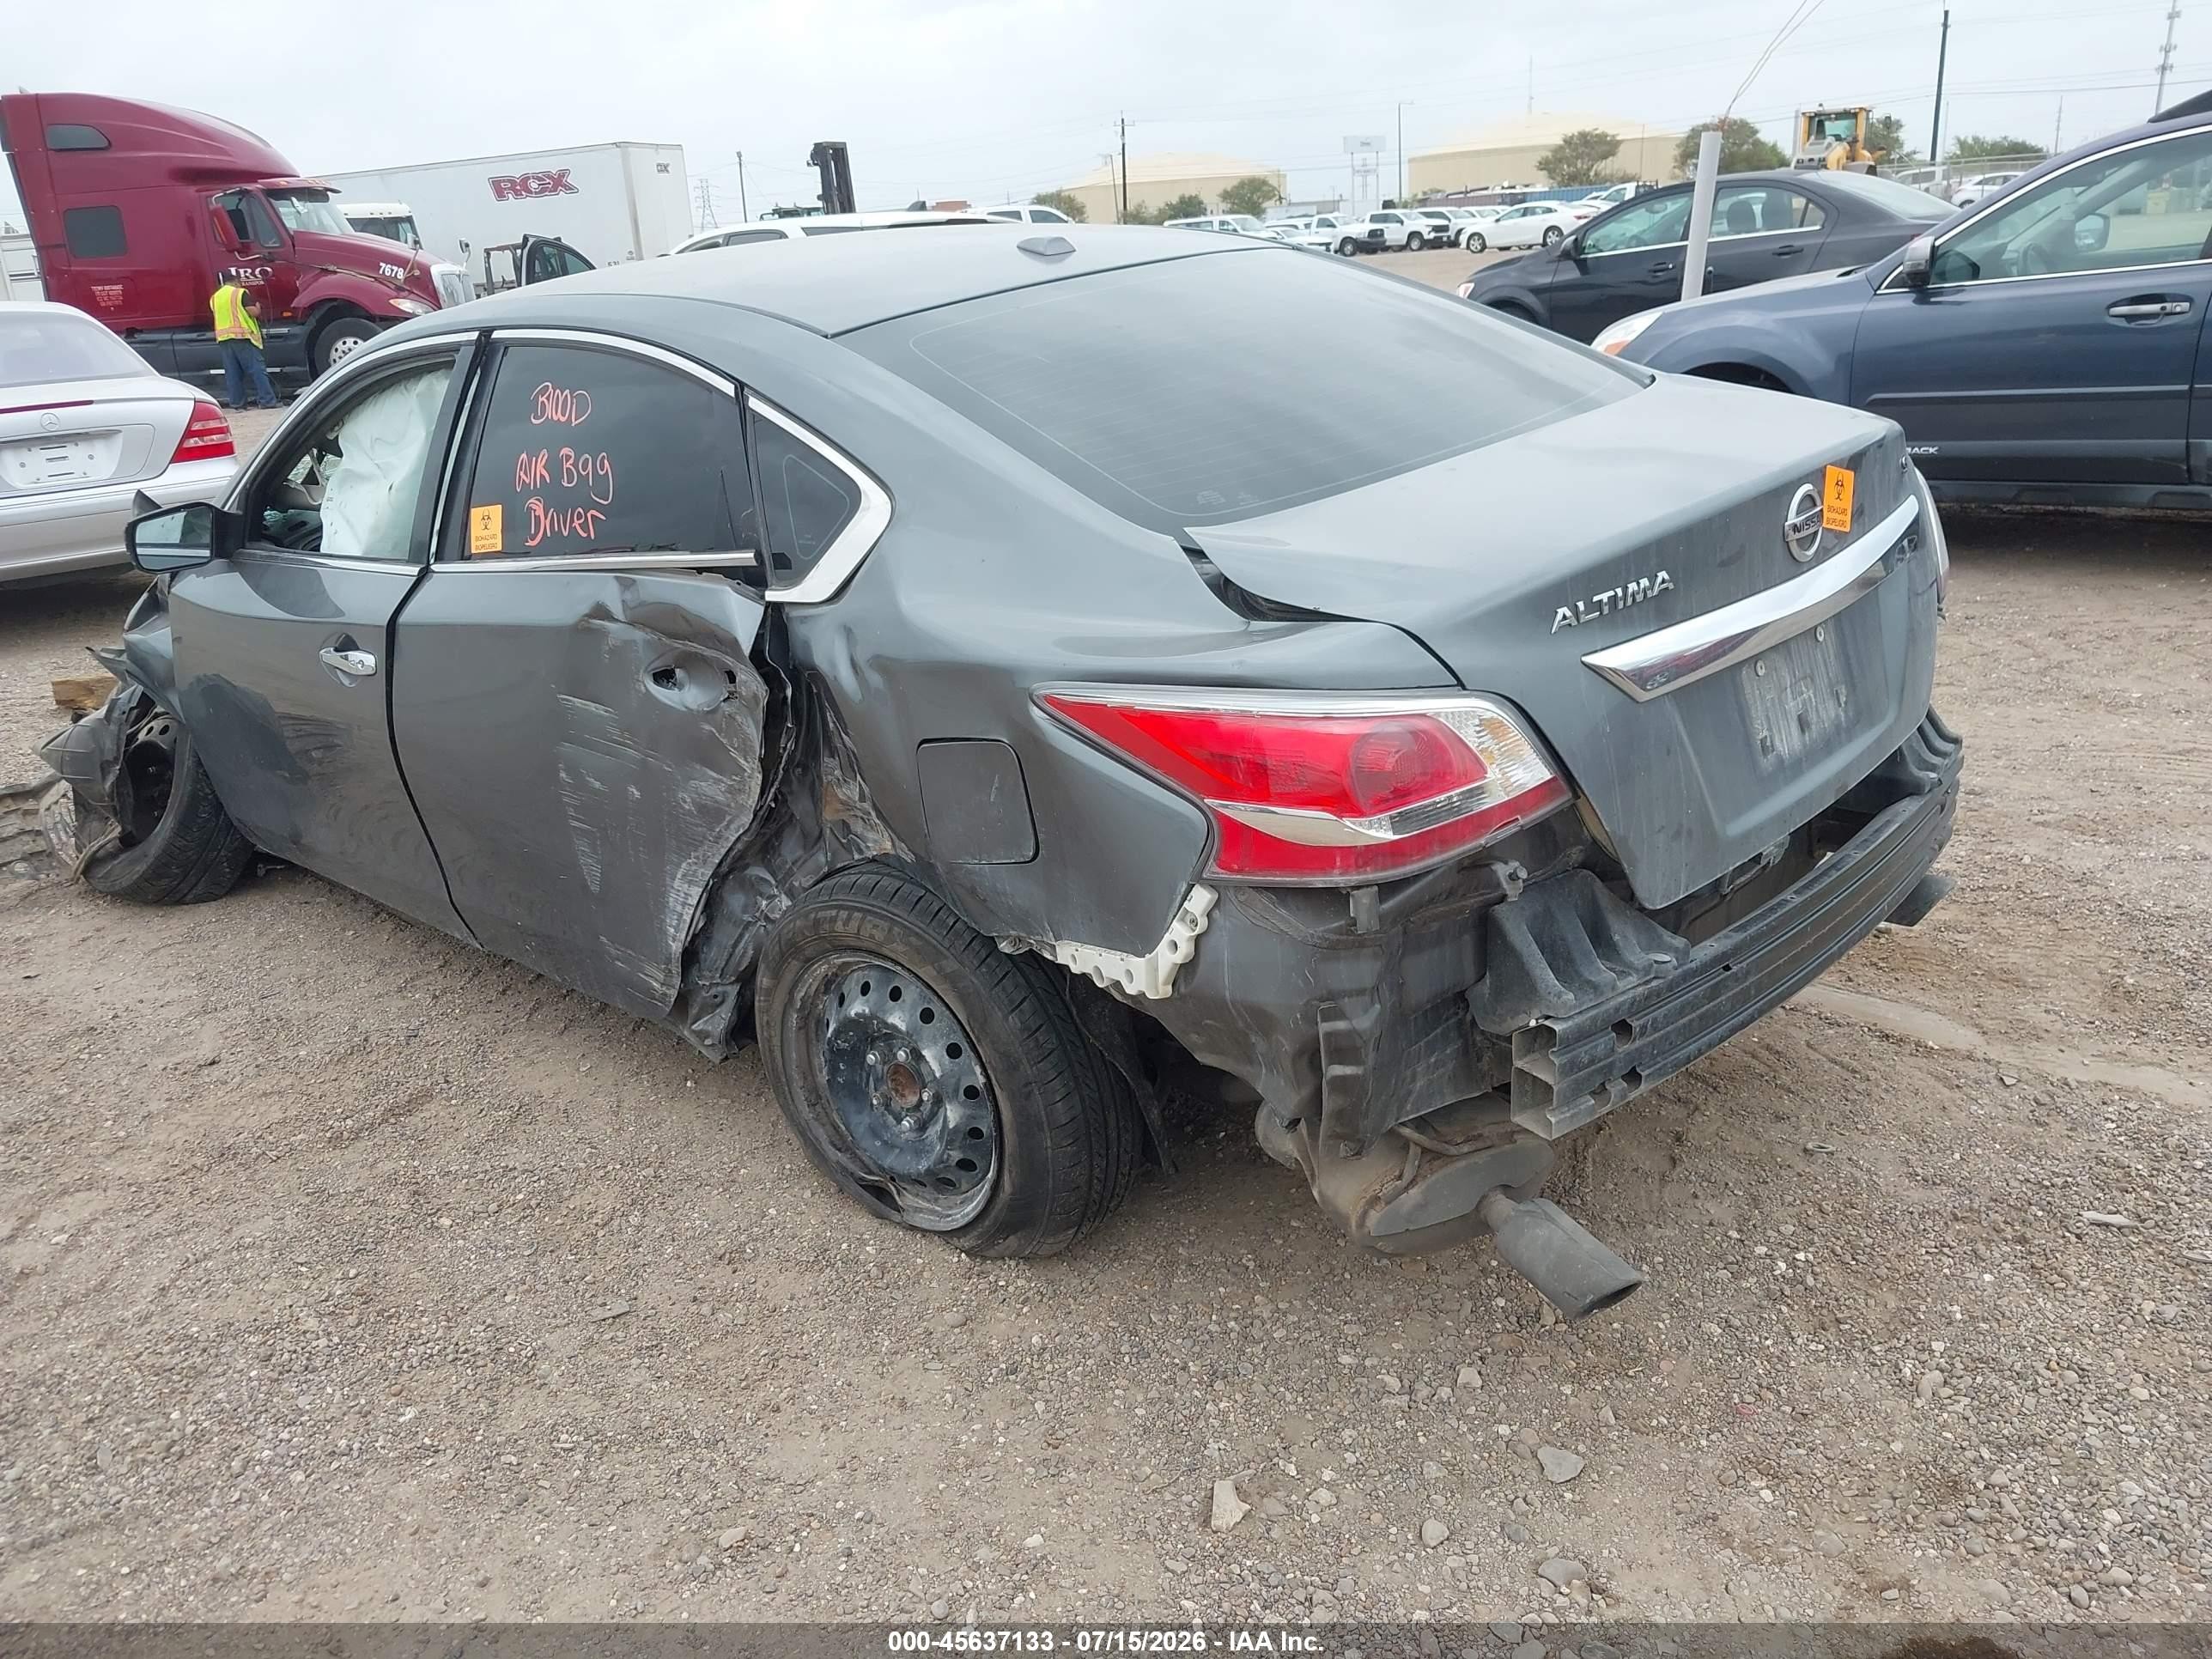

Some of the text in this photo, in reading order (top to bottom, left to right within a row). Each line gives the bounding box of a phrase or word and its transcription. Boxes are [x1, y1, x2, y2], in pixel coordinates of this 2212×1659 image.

[488, 169, 579, 201] RCX
[380, 262, 404, 280] 7678
[515, 448, 550, 493] AIR
[524, 495, 607, 547] Driver
[1791, 515, 1822, 536] NISSA
[1826, 504, 1848, 517] BIOHAZARD
[1549, 569, 1675, 635] ALTIMA
